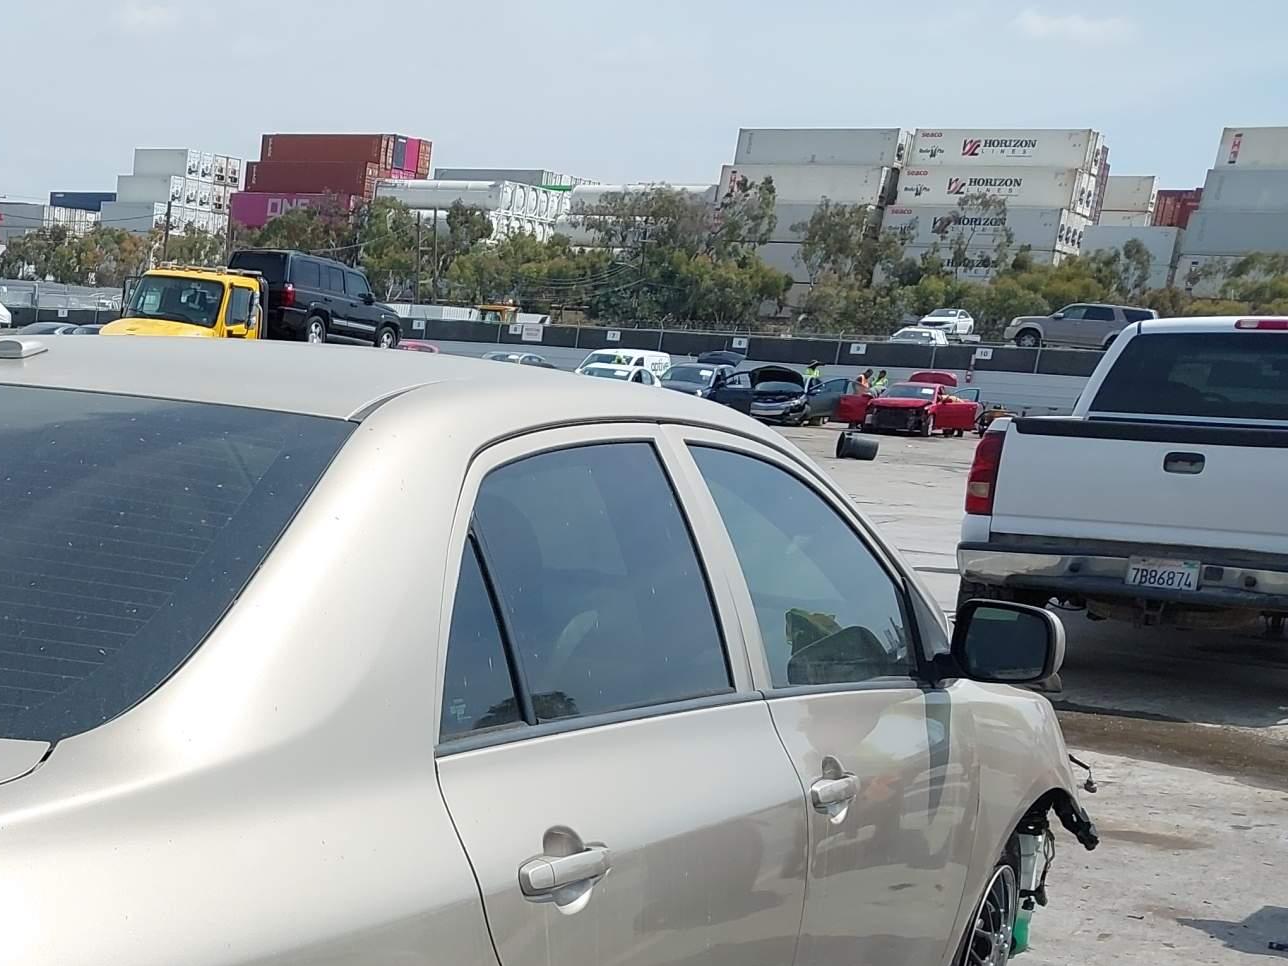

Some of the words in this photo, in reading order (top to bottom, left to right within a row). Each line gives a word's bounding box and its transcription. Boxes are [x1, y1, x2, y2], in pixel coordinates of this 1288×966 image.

[983, 139, 1038, 148] HORIZON
[968, 177, 1023, 187] HORIZON
[1131, 567, 1193, 588] 7B86874
